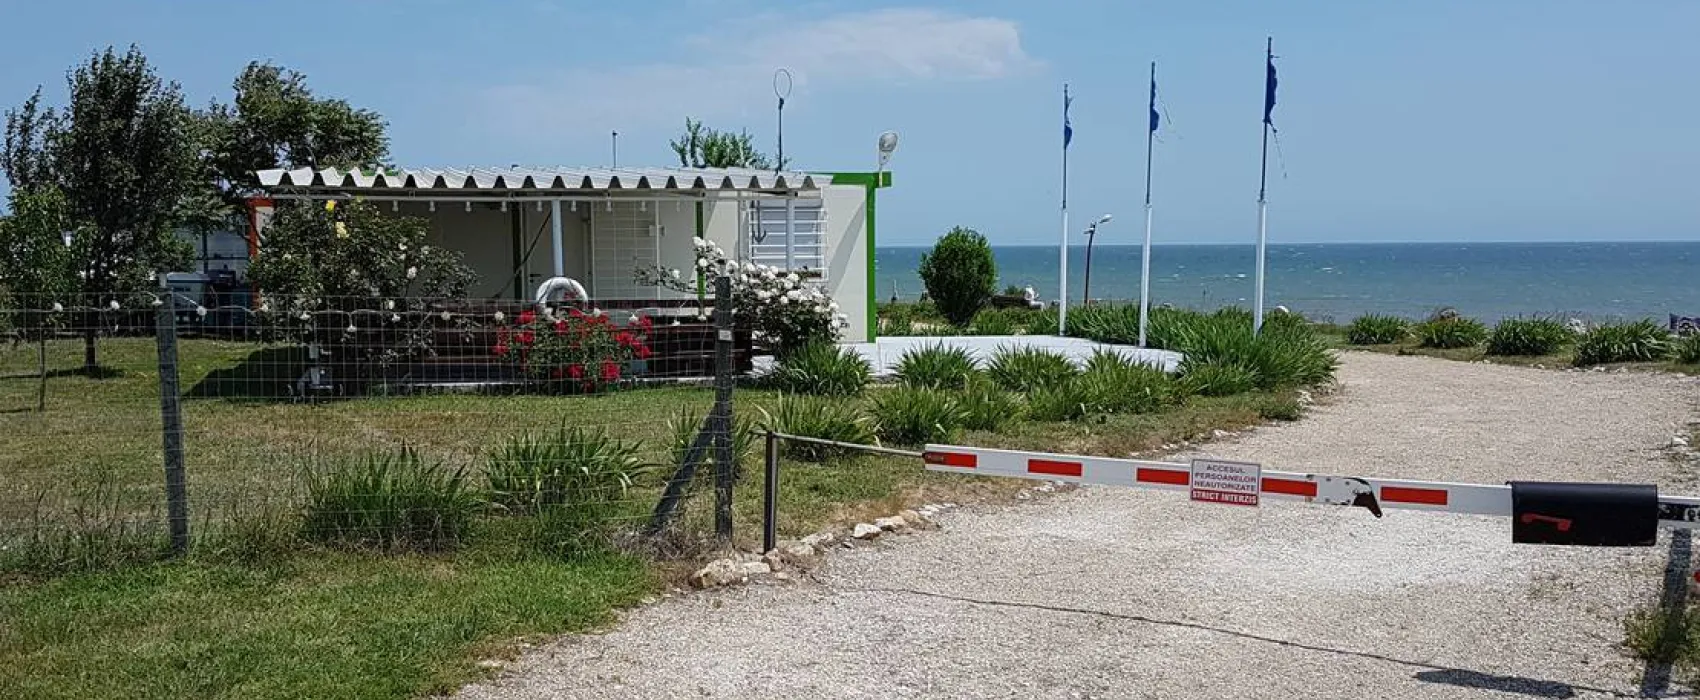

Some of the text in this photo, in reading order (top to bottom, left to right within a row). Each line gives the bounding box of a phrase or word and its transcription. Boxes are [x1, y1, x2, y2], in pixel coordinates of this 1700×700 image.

[1206, 464, 1246, 473] ACCESUL
[1195, 473, 1256, 482] PERSOANELOR
[1194, 481, 1256, 491] NEAUTORIZATE
[1192, 491, 1257, 504] STRICT INTERZIS
